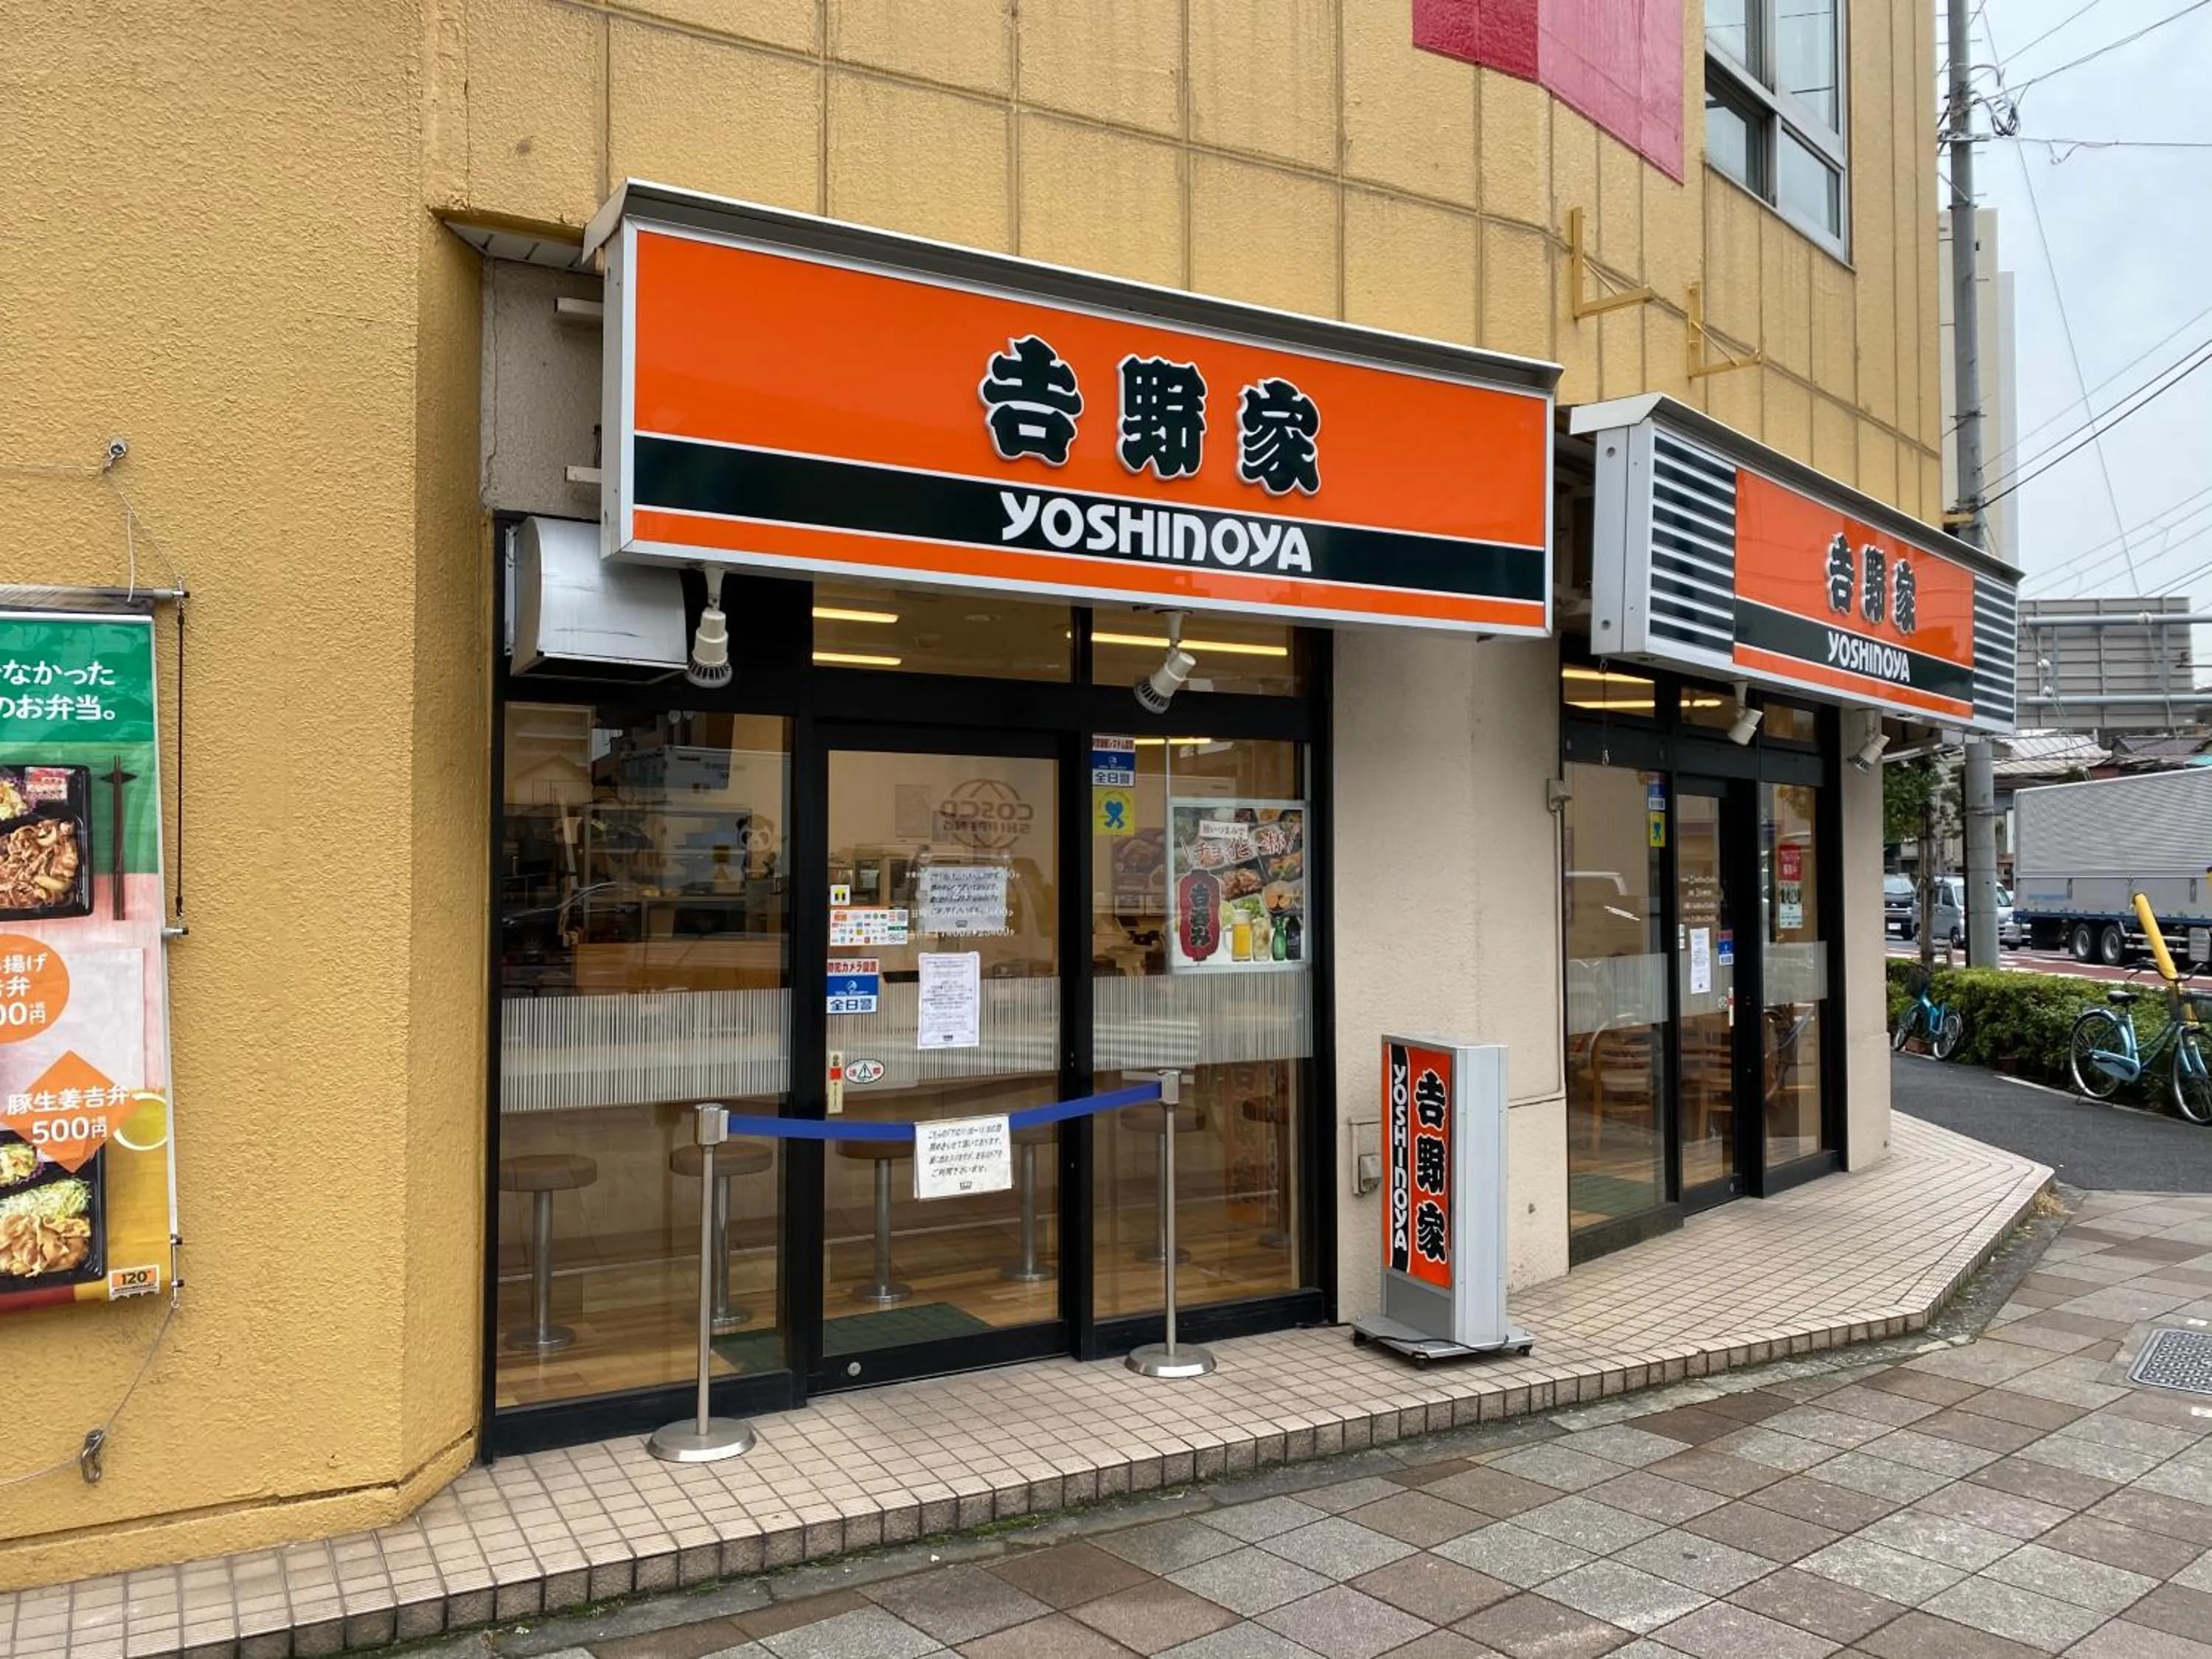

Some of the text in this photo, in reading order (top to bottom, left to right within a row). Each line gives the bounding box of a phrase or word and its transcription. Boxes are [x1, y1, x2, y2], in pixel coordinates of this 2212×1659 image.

[978, 335, 1322, 497] 吉野家
[1001, 492, 1312, 573] YOSHINOYA
[1825, 532, 1916, 636] 吉野家
[0, 658, 116, 686] なかった
[1828, 630, 1910, 683] YOSHINOYA
[0, 694, 116, 720] のお弁当。
[0, 952, 48, 974] 揚げ
[1393, 1064, 1408, 1251] YOSHINOYA
[1414, 1068, 1447, 1264] 吉野家
